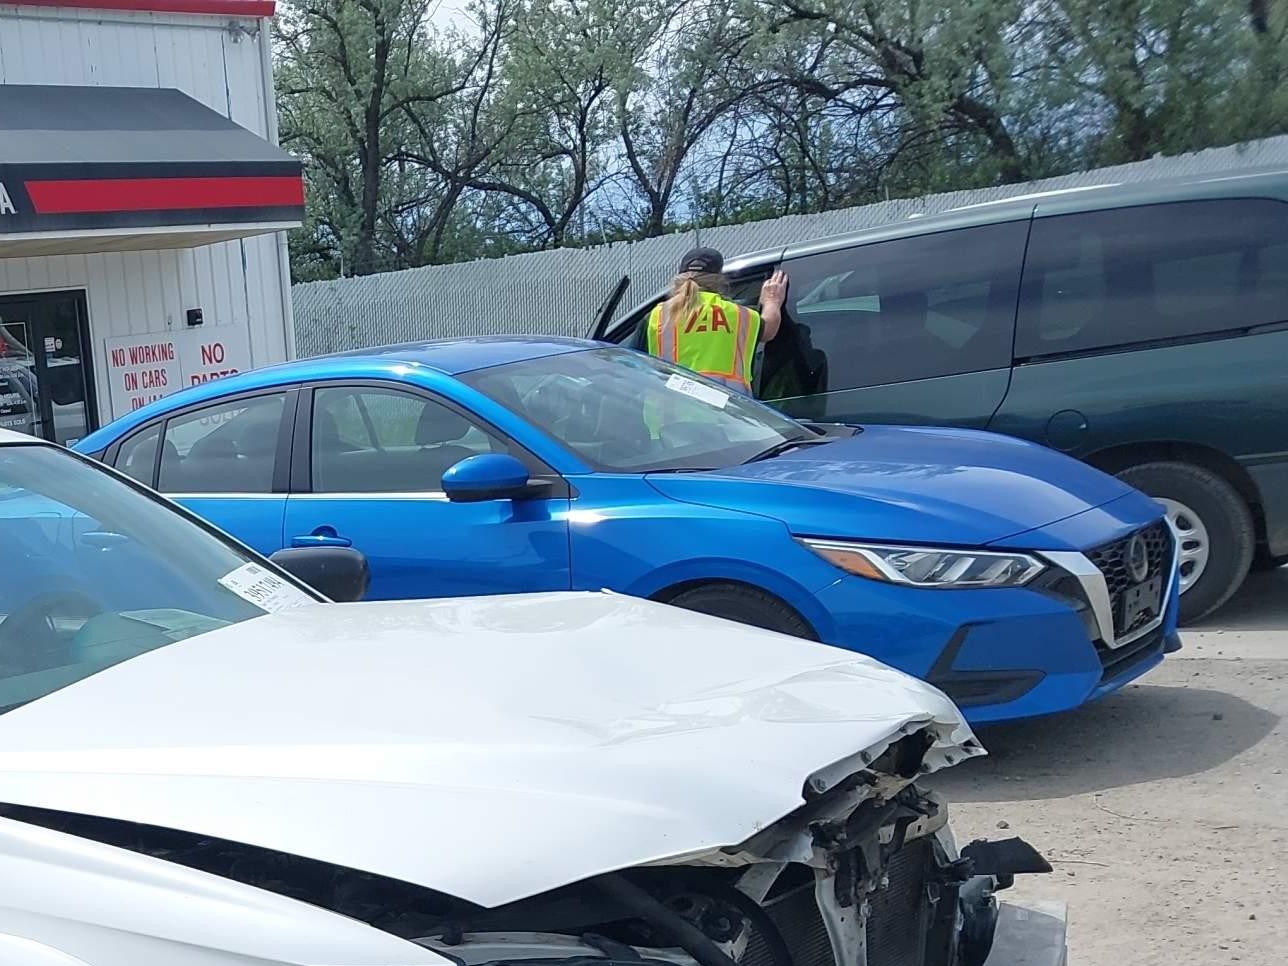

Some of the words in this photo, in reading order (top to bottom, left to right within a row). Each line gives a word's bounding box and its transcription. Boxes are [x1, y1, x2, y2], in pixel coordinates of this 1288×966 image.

[112, 348, 126, 367] NO
[129, 343, 174, 365] WORKING
[201, 343, 225, 365] NO
[124, 373, 138, 391] ON
[142, 369, 168, 389] CARS
